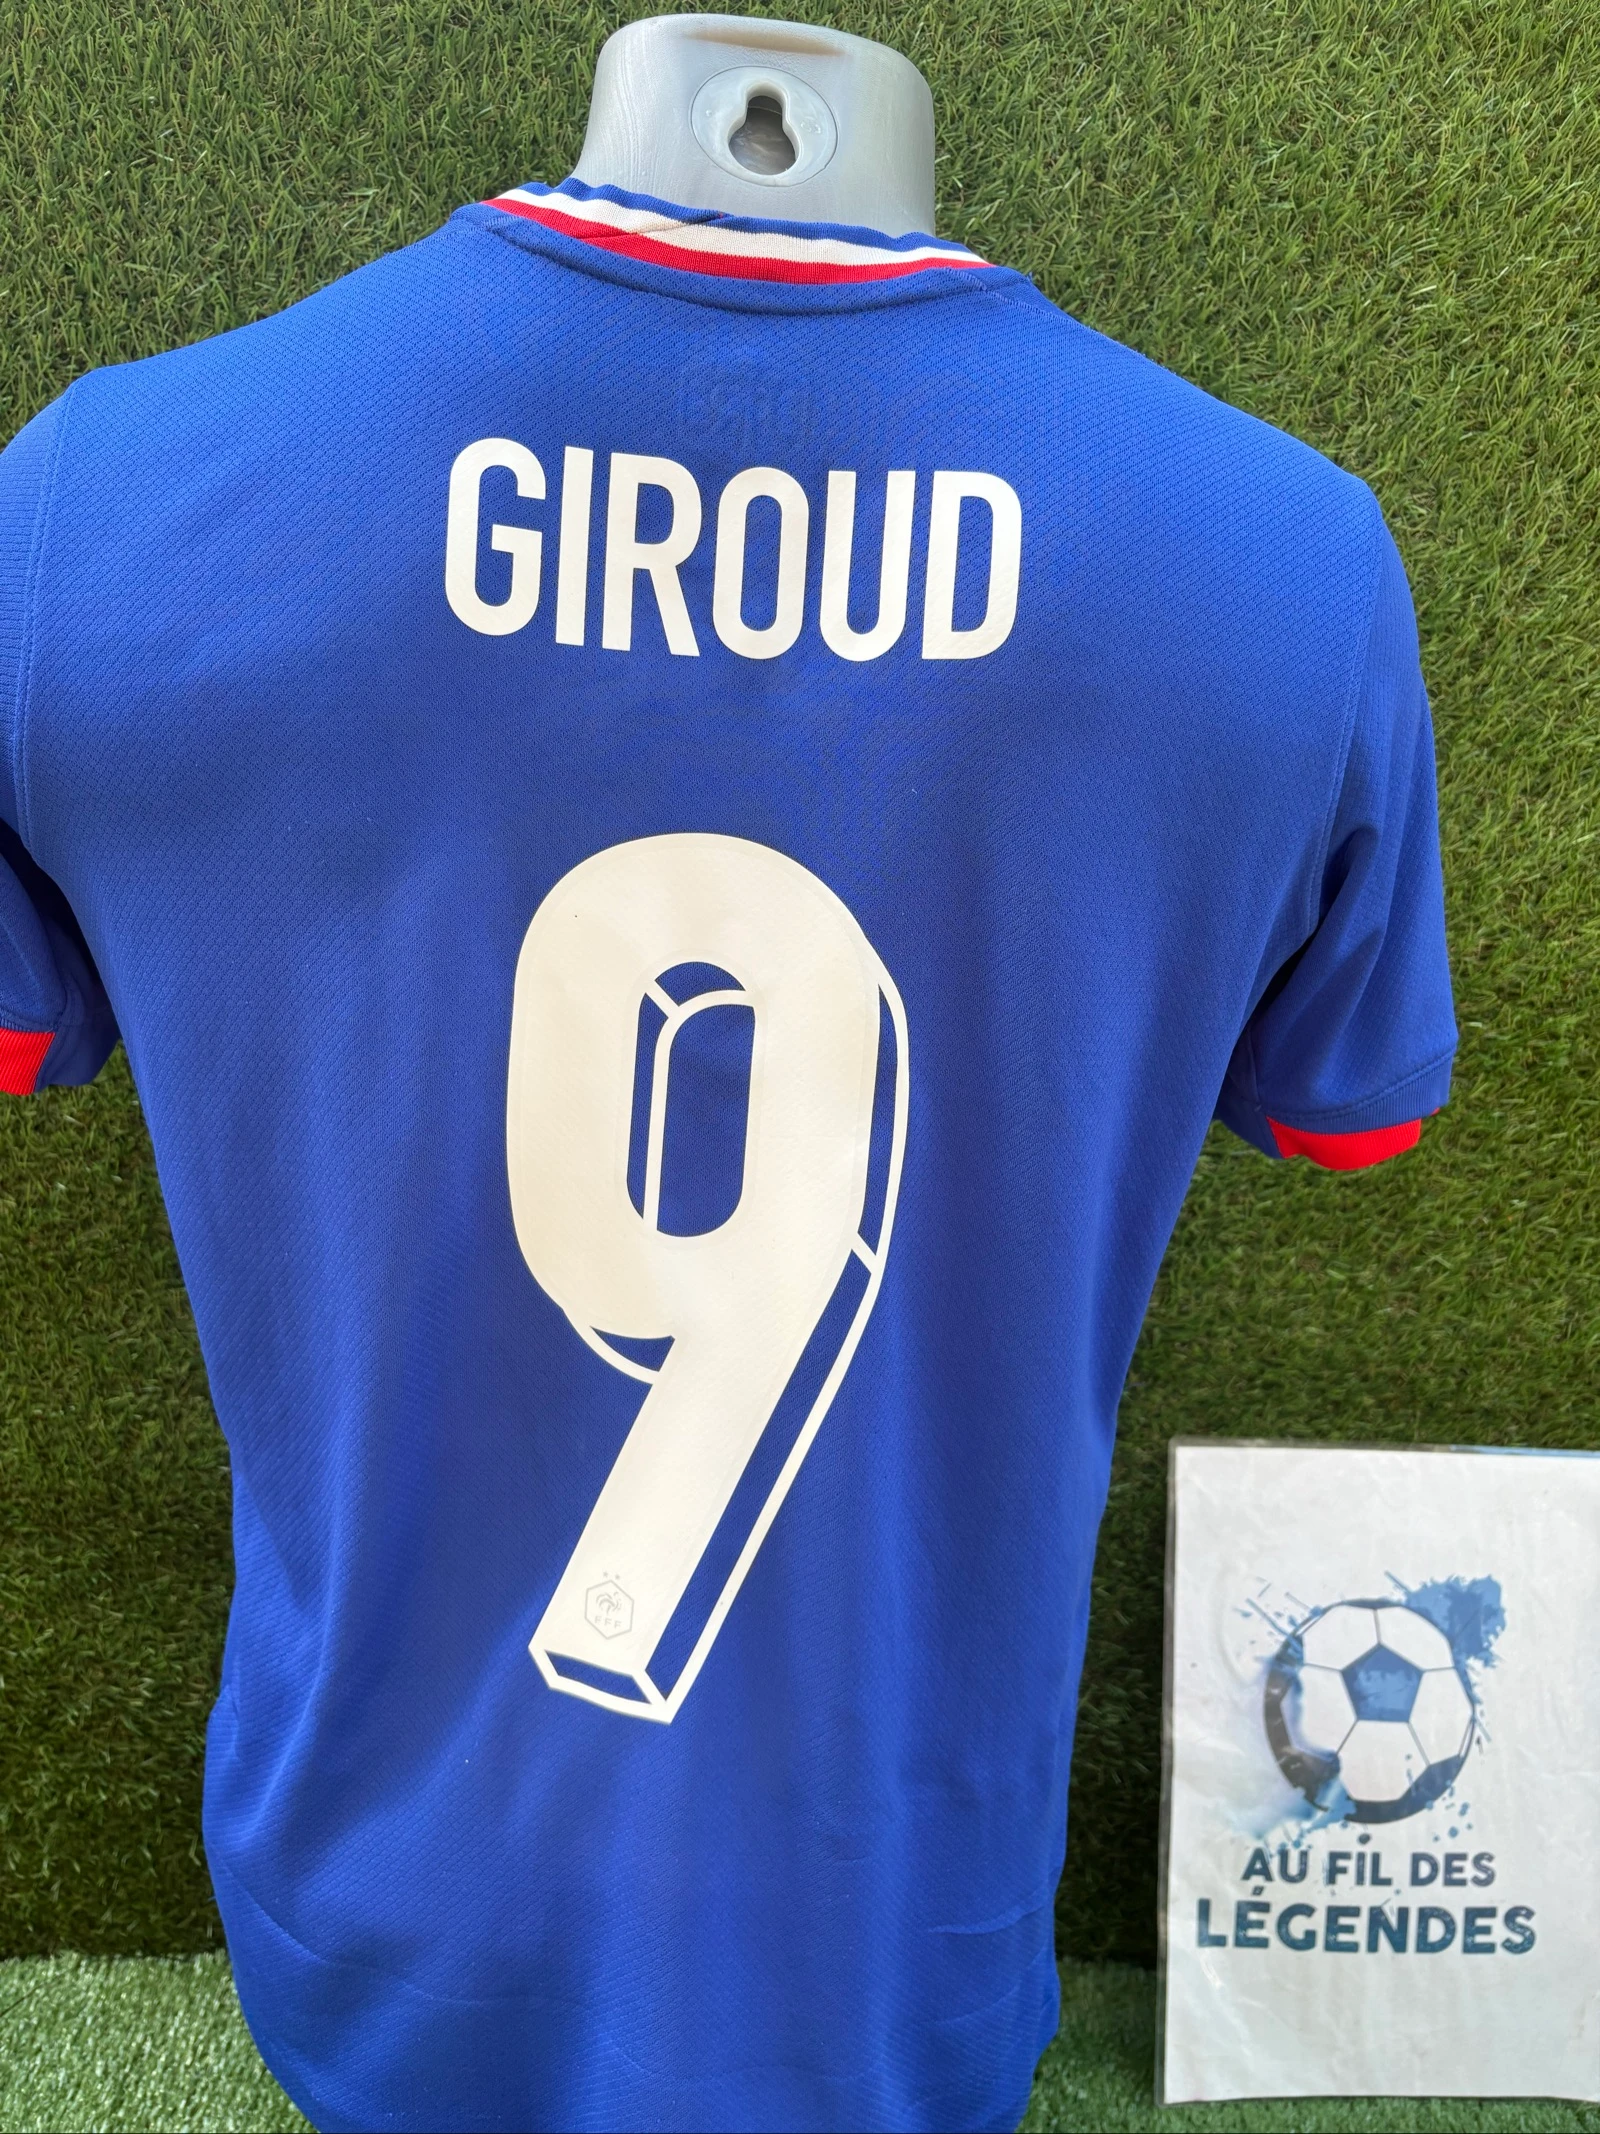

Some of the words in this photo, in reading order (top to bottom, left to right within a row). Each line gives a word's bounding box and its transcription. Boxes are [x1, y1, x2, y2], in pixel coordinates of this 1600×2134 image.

[445, 438, 1022, 661] GIROUD
[506, 833, 909, 1724] 9
[1197, 1886, 1536, 1955] LÉGENDES
[1241, 1847, 1309, 1884] AU
[1325, 1850, 1393, 1887] FIL
[1410, 1852, 1495, 1887] DES
